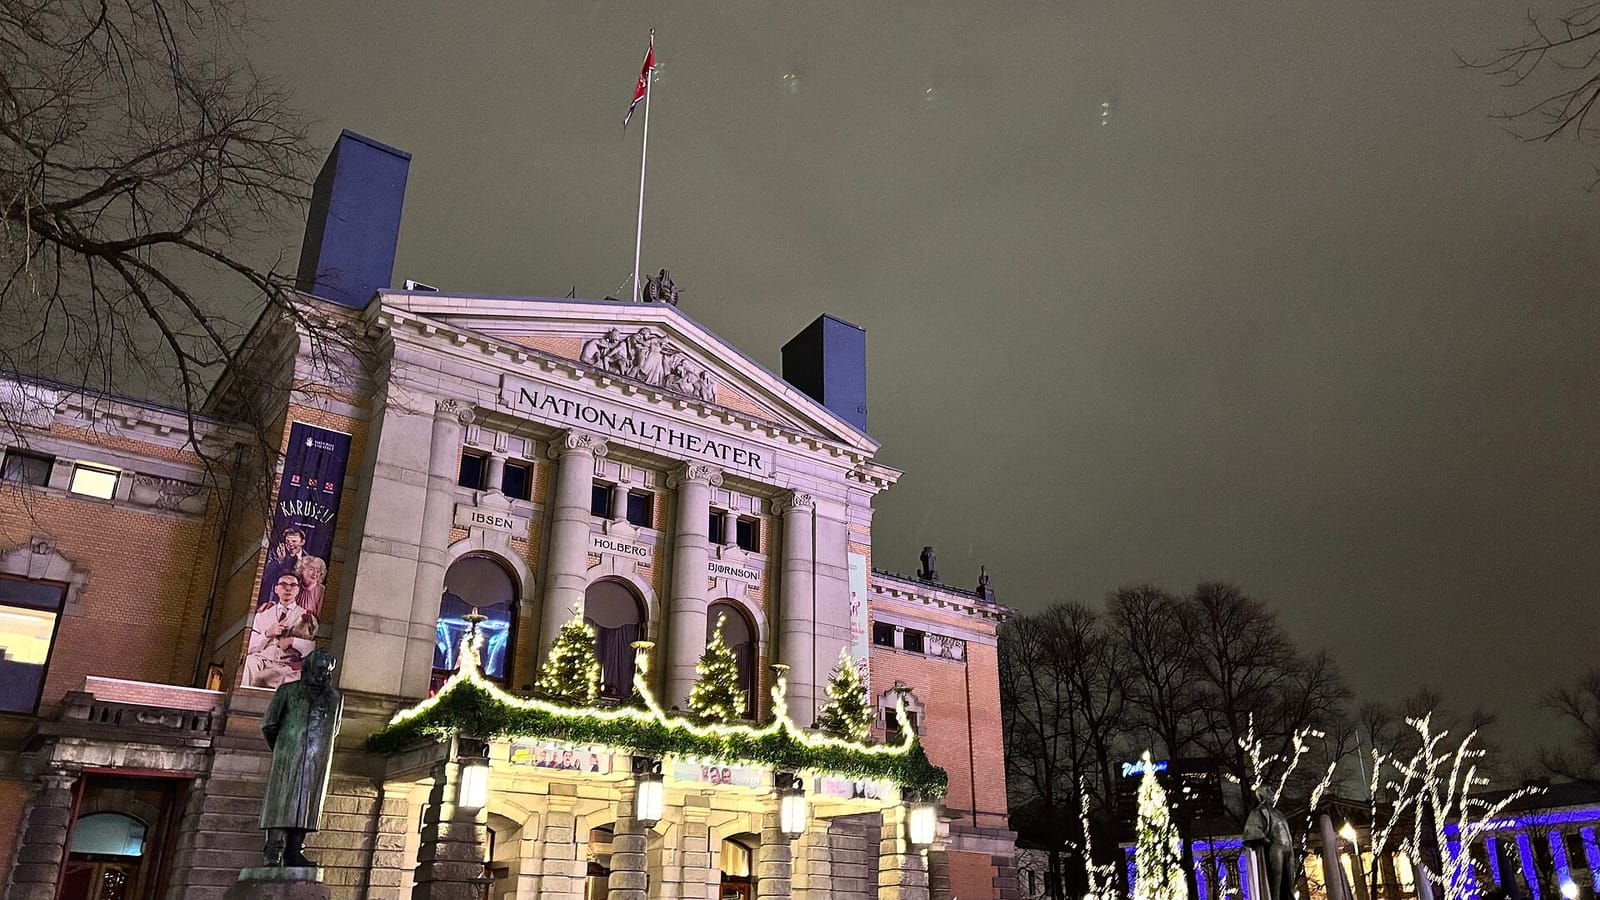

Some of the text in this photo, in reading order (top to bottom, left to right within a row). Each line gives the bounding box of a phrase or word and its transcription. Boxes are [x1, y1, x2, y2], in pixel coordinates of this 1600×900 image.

[518, 387, 762, 470] NATIONALTHEATER
[472, 512, 513, 530] IBSEN
[594, 538, 647, 557] HOLBERG
[708, 562, 758, 580] BJØRNSON
